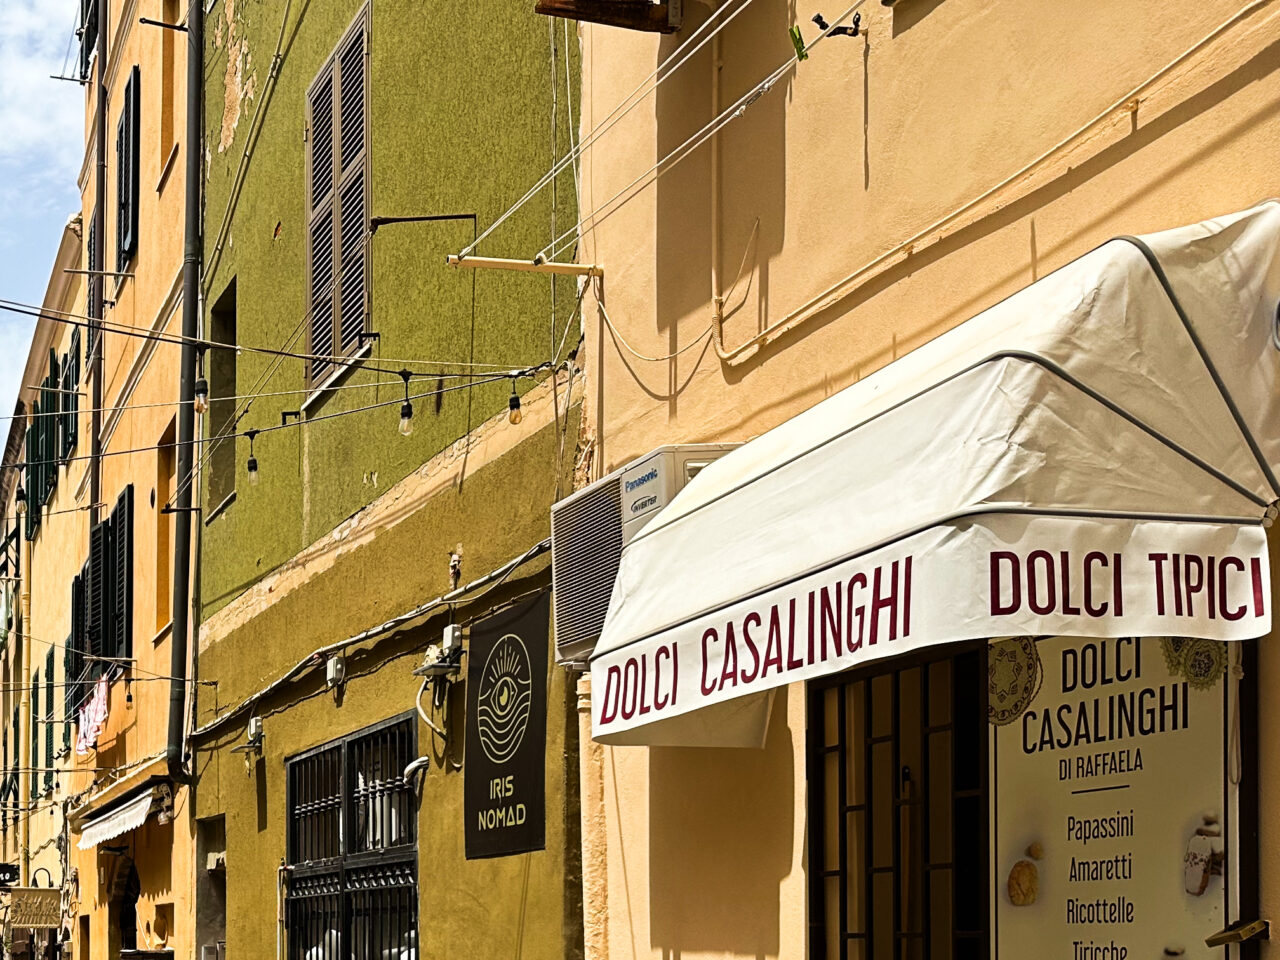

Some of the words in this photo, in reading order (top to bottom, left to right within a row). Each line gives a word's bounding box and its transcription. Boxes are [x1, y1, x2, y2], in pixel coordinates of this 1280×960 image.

[624, 467, 658, 493] Panasonic
[989, 550, 1124, 618] DOLCI
[1148, 552, 1265, 622] TIPICI
[599, 641, 679, 726] DOLCI
[700, 555, 914, 697] CASALINGHI
[1061, 637, 1142, 694] DOLCI
[1022, 681, 1190, 754] CASALINGHI
[1059, 758, 1072, 781] DI
[1076, 748, 1144, 779] RAFFAELA
[490, 775, 514, 800] IRIS
[478, 803, 526, 832] NOMAD
[1067, 810, 1134, 846] Papassini
[1069, 853, 1132, 883] Amaretti
[1066, 896, 1135, 925] Ricottelle
